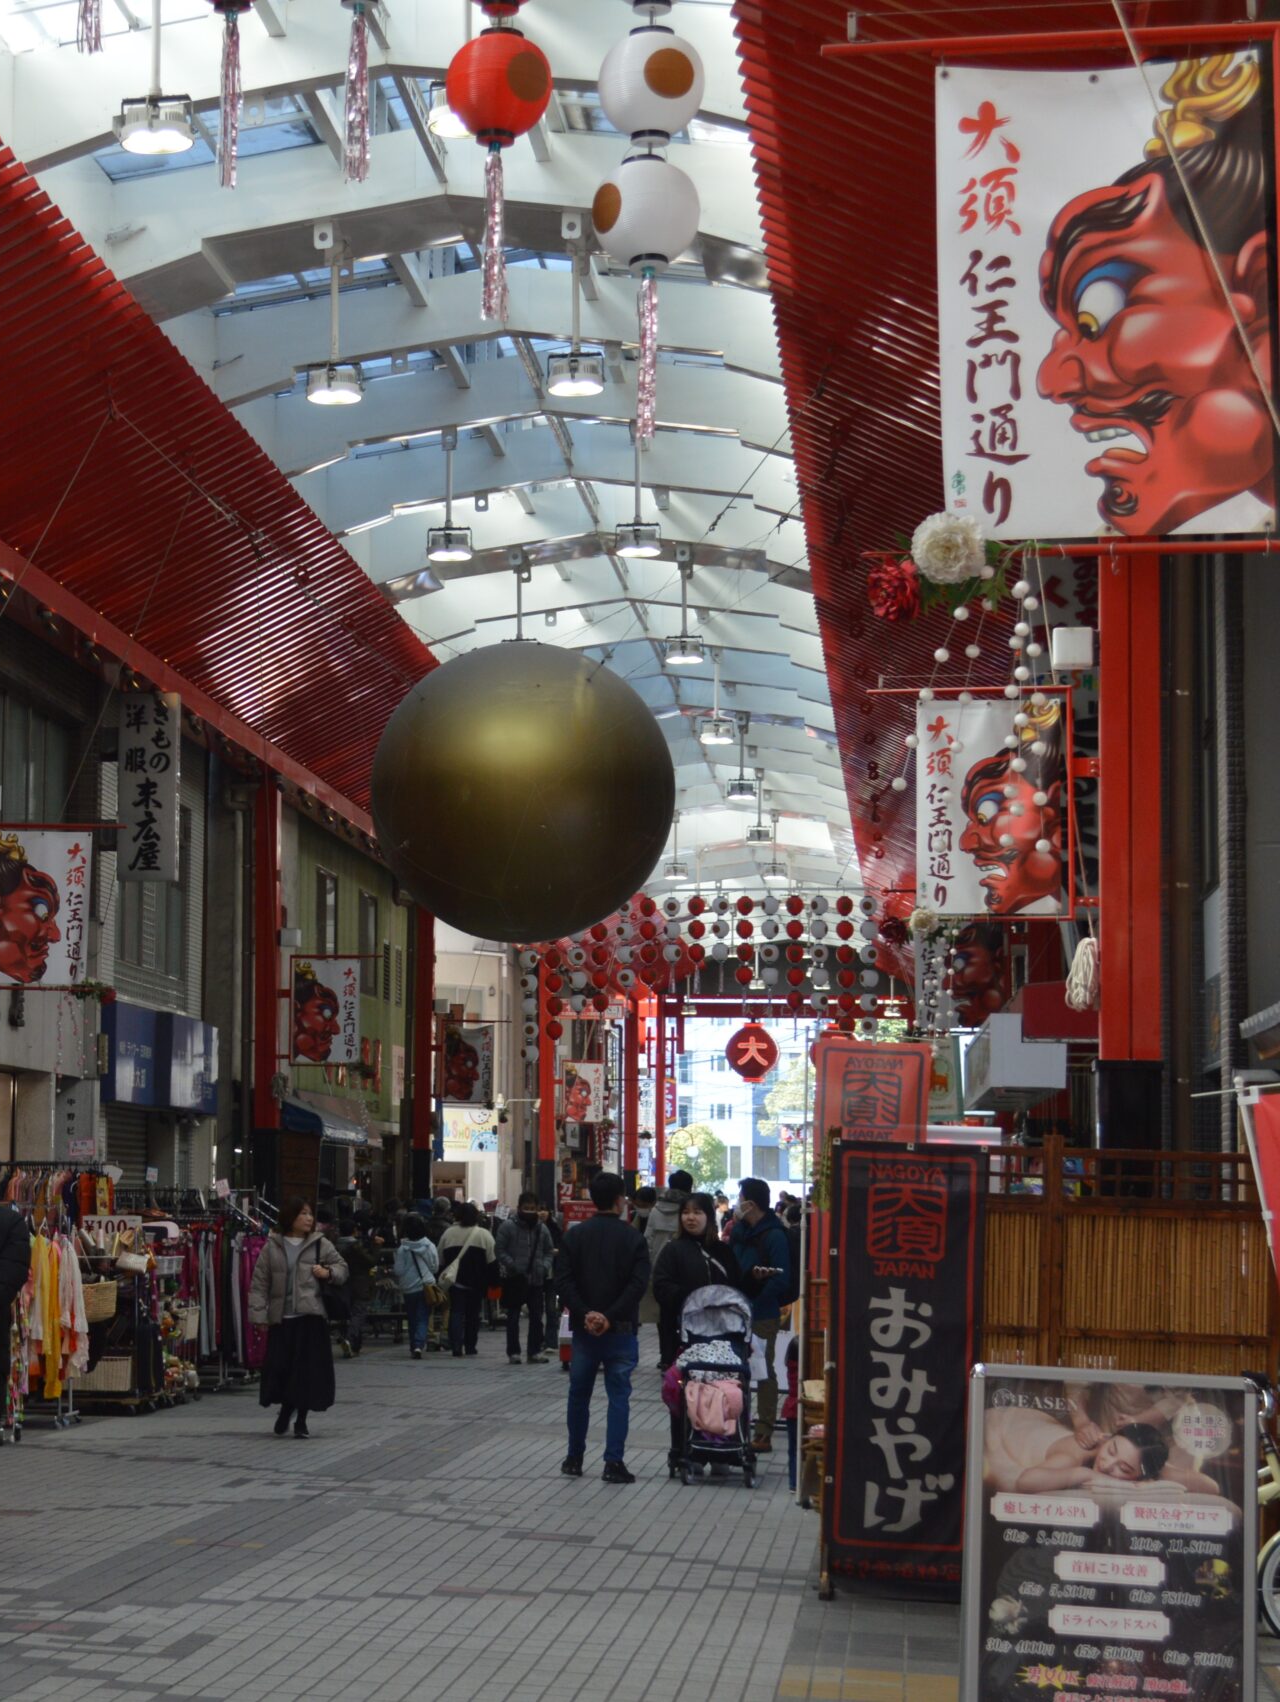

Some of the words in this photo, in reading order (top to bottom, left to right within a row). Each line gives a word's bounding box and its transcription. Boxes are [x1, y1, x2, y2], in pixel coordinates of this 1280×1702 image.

[958, 100, 1031, 528] 大須仁王門通り
[124, 704, 148, 773] 洋服
[926, 715, 955, 908] 大須仁王門通り
[65, 842, 86, 981] 大須仁王門通り
[342, 967, 357, 1060] 大須仁王門通り
[737, 1036, 769, 1066] 大
[868, 1163, 946, 1184] NAGOYA
[873, 1261, 936, 1280] JAPAN
[863, 1286, 956, 1532] おみやげ
